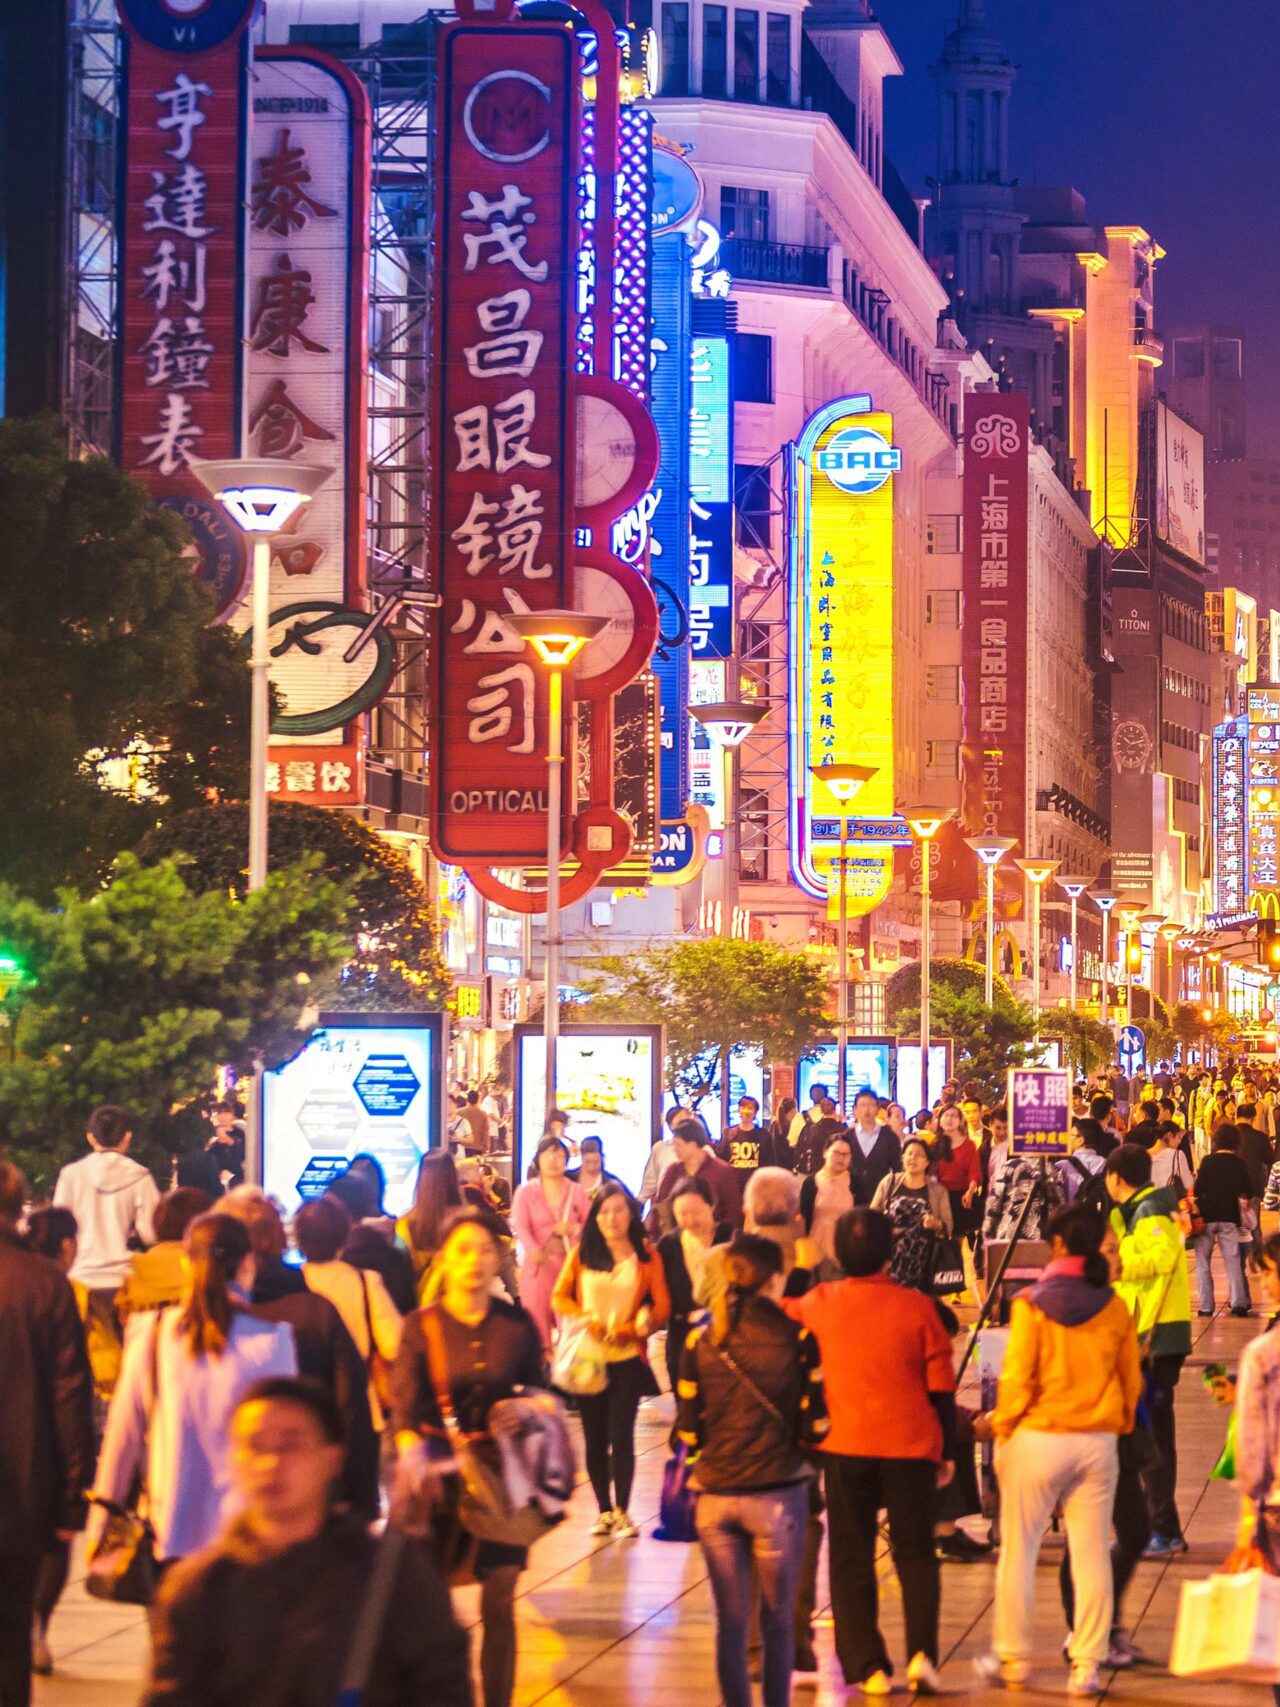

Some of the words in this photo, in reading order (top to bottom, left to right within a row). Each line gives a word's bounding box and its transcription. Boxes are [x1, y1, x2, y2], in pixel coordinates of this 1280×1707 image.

[454, 184, 553, 754] 茂昌眼镜公司
[820, 451, 898, 469] BAC
[981, 473, 1008, 733] 上海市第一食品商店
[1119, 618, 1150, 631] TITONI
[451, 789, 550, 814] OPTICAL
[1258, 825, 1278, 885] 真丝大王
[1222, 910, 1259, 926] PHARMACY
[1014, 1074, 1068, 1107] 快照
